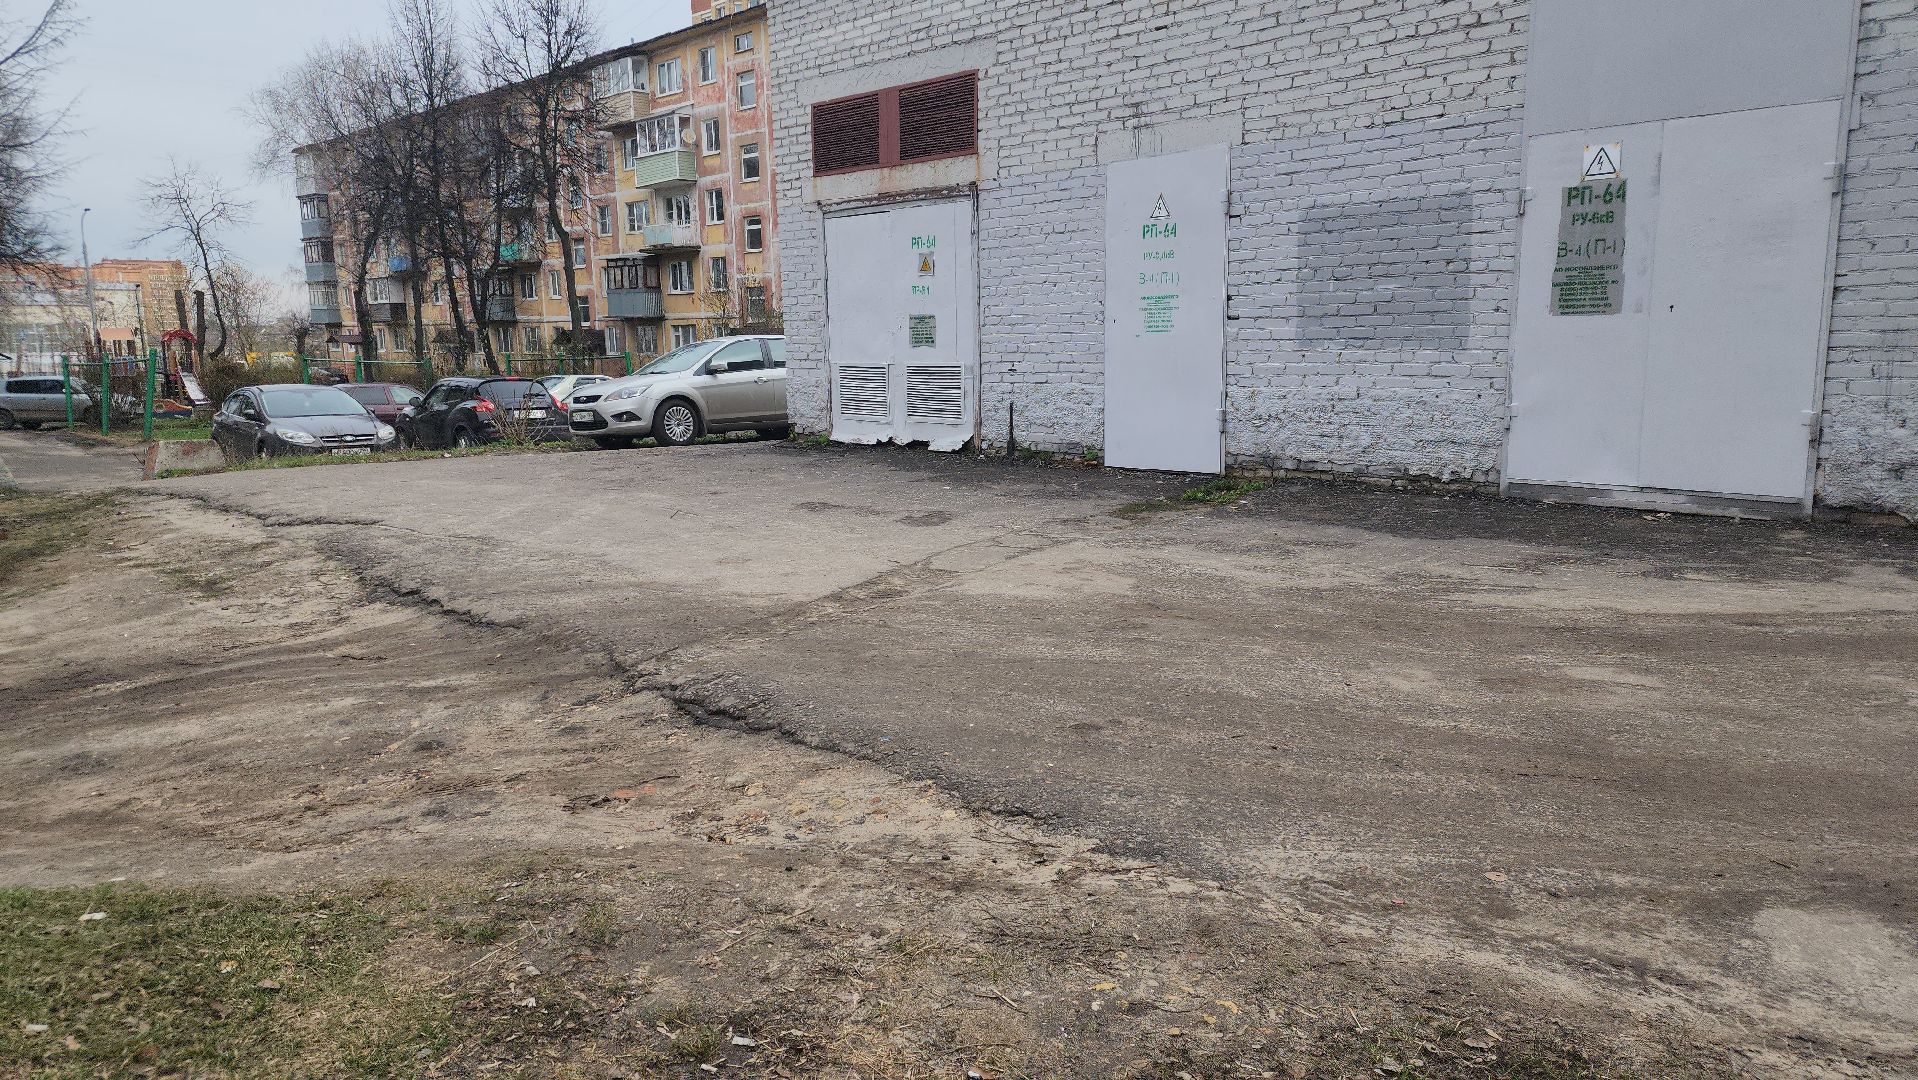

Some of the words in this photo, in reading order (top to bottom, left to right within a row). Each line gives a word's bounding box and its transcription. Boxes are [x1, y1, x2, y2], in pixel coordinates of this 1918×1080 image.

[1566, 180, 1627, 207] РП-64
[1142, 222, 1177, 240] РП-64
[911, 235, 936, 250] РП-64
